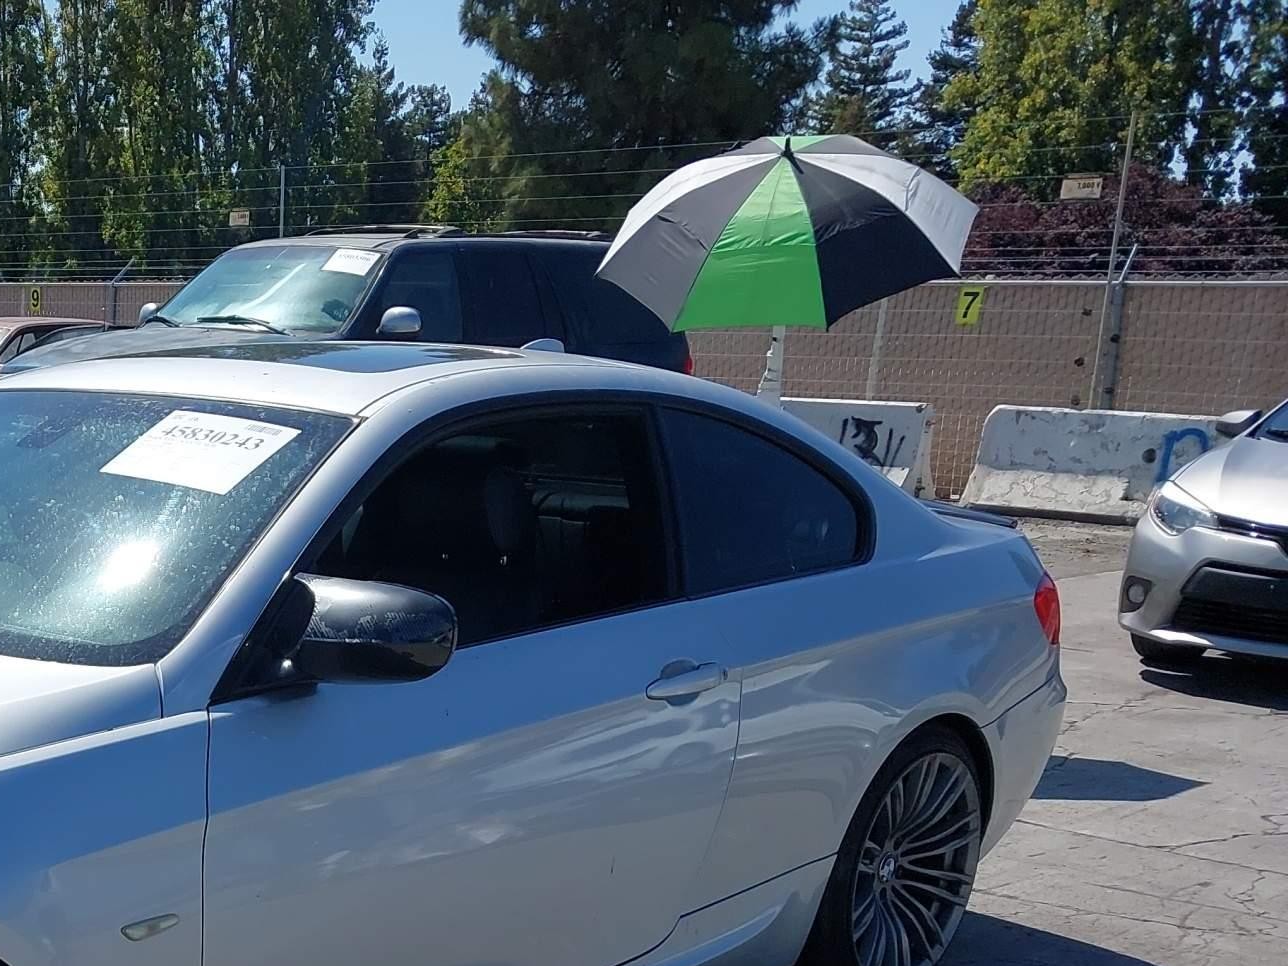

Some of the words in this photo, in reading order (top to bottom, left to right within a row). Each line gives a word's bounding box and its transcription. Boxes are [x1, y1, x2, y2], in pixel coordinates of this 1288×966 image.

[32, 289, 40, 308] 9
[962, 291, 980, 319] 7
[161, 424, 265, 451] 45830243
